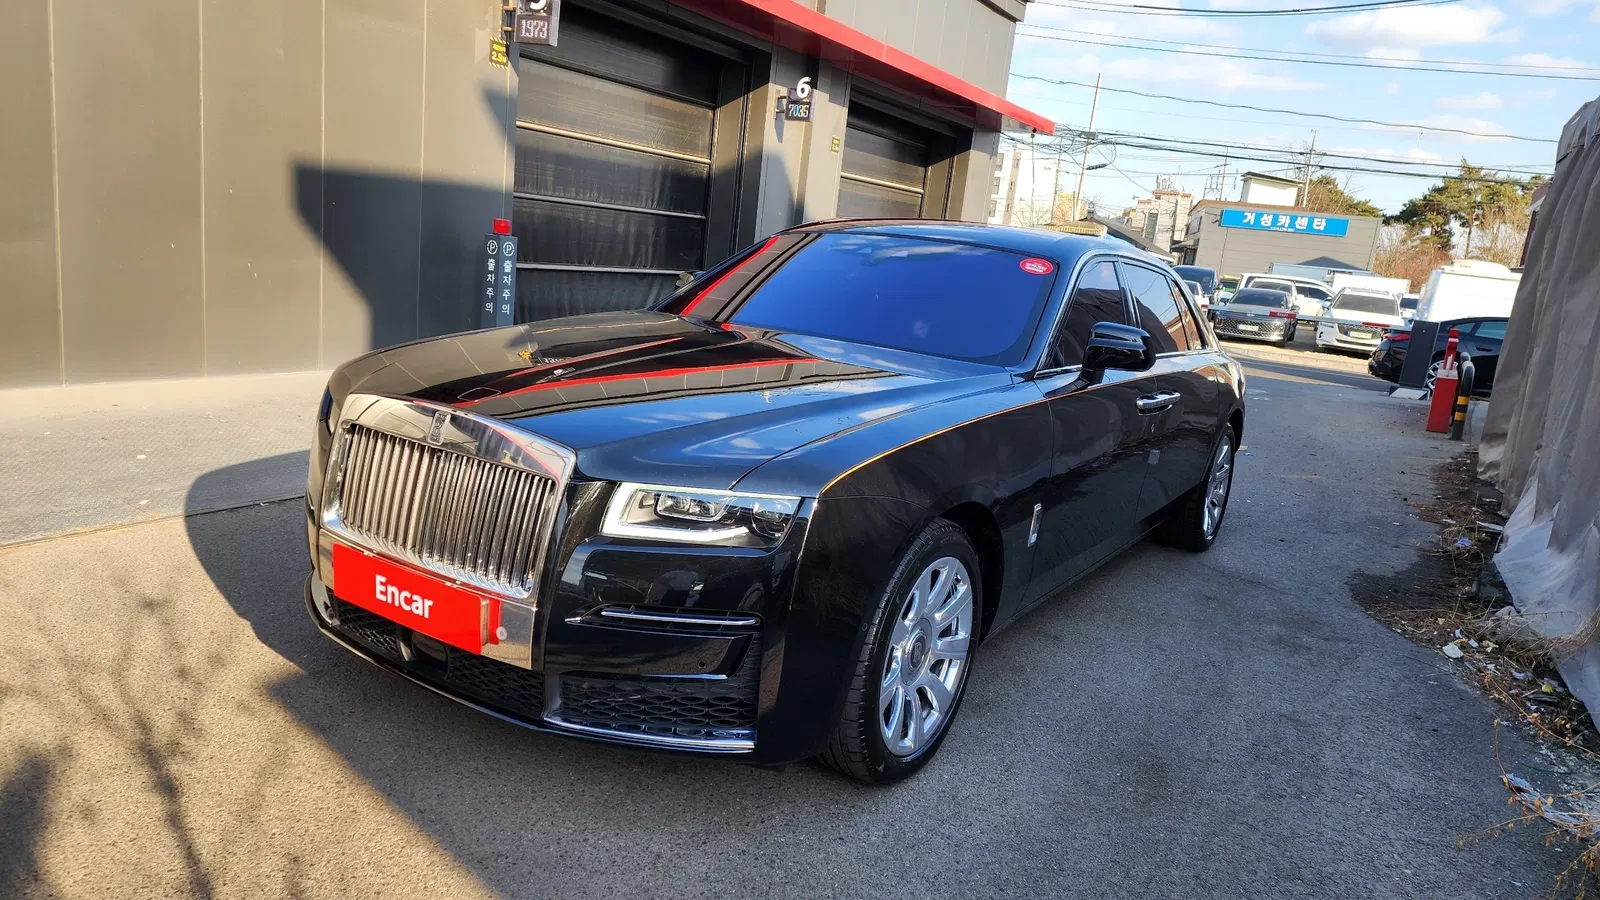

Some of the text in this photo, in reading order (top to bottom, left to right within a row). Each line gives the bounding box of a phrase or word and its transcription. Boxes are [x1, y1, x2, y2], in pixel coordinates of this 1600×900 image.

[520, 19, 548, 39] 1973
[796, 76, 811, 99] 6
[1242, 212, 1327, 231] 거성카센타
[375, 574, 434, 619] Encar
